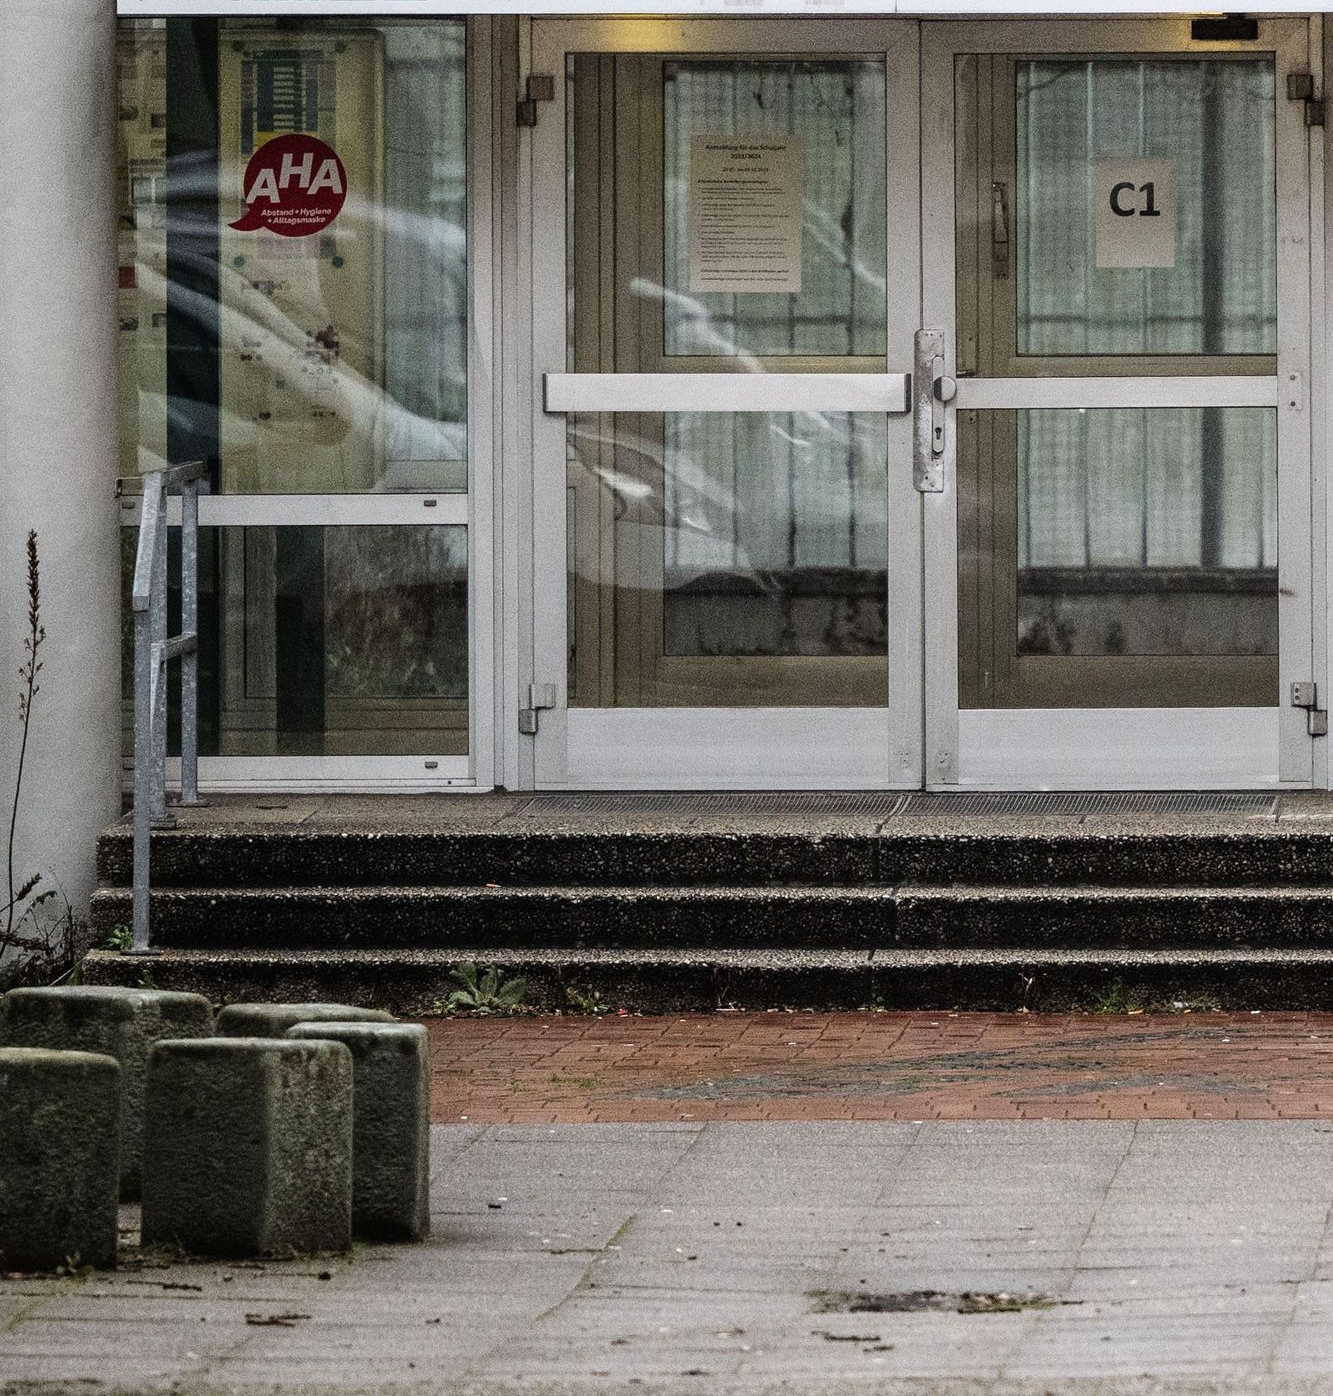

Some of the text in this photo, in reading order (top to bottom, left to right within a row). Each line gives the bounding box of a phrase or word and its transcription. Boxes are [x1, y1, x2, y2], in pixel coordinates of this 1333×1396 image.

[245, 152, 343, 204] AHA
[1110, 181, 1161, 217] C1
[261, 208, 294, 216] Abstand
[300, 207, 332, 217] Hygiene
[273, 216, 326, 225] Alltagsmaske
